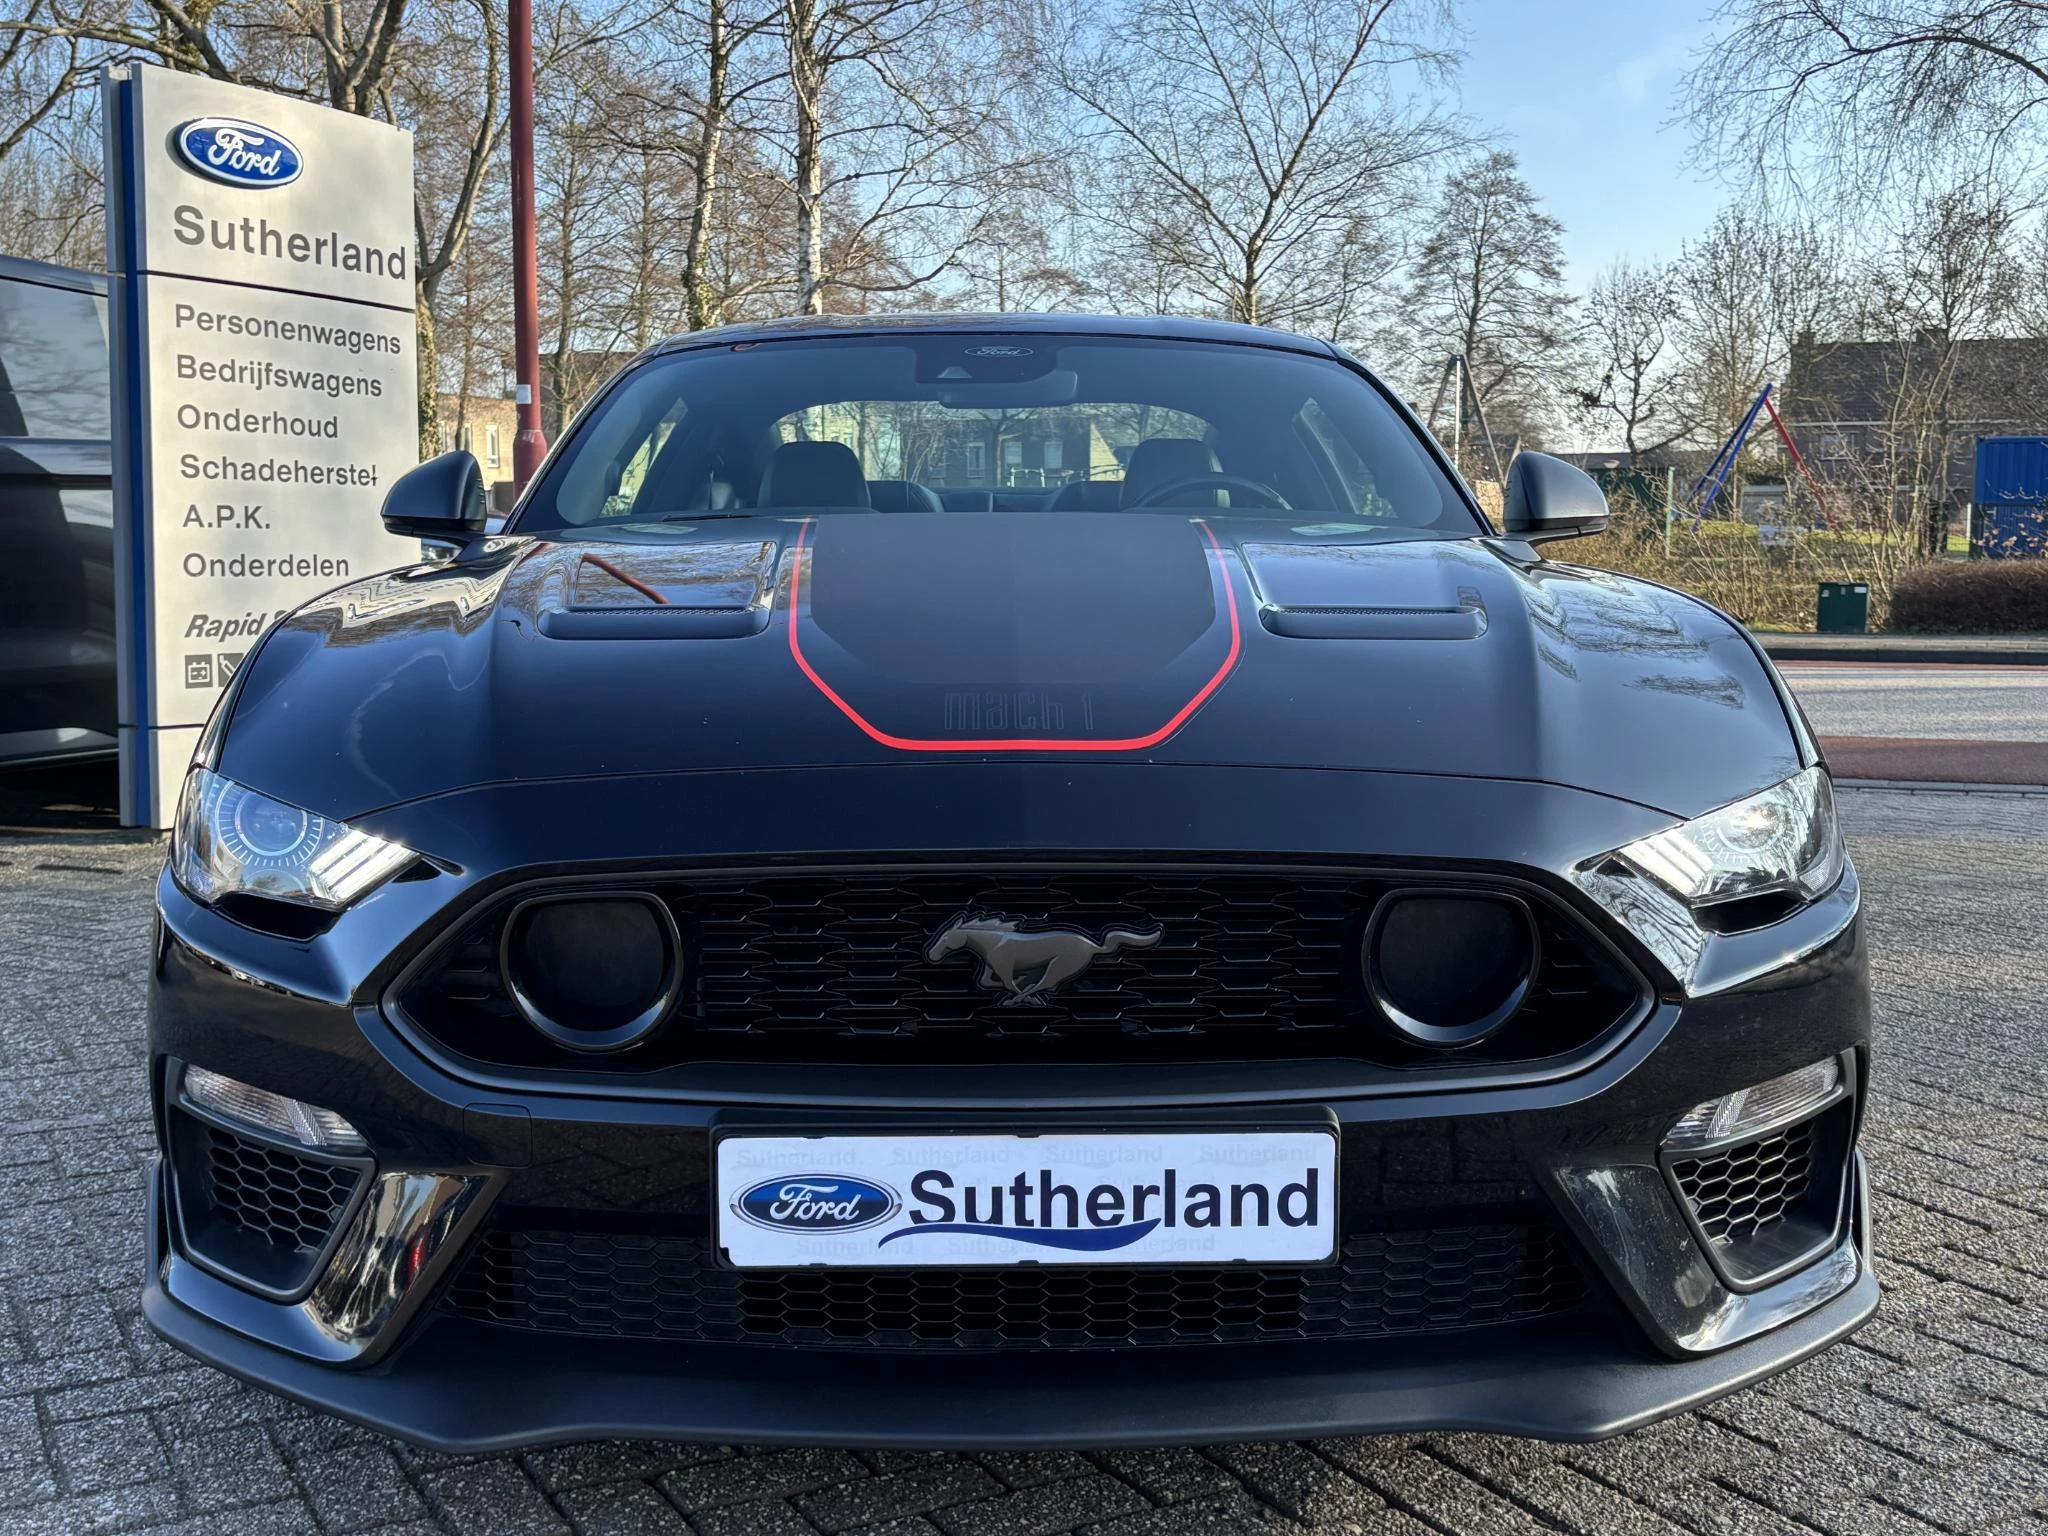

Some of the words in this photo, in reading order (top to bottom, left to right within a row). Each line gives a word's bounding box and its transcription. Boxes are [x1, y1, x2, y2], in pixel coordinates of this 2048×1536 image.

[207, 127, 282, 176] Ford
[173, 204, 406, 280] Sutherland
[175, 303, 400, 354] Personenwagens
[976, 345, 1021, 356] Ford
[177, 354, 382, 397] Bedrijfswagens
[177, 404, 338, 438] Onderhoud
[180, 453, 377, 486] Schadeherstel
[183, 504, 271, 529] A.P.K.
[183, 553, 349, 577] Onderdelen
[184, 612, 268, 642] Rapid
[736, 1148, 856, 1166] Sutherland
[892, 1146, 1010, 1164] Sutherland
[1046, 1144, 1164, 1162] Sutherland
[1199, 1144, 1316, 1161] Sutherland
[769, 1183, 861, 1220] Ford
[909, 1168, 1319, 1228] Sutherland
